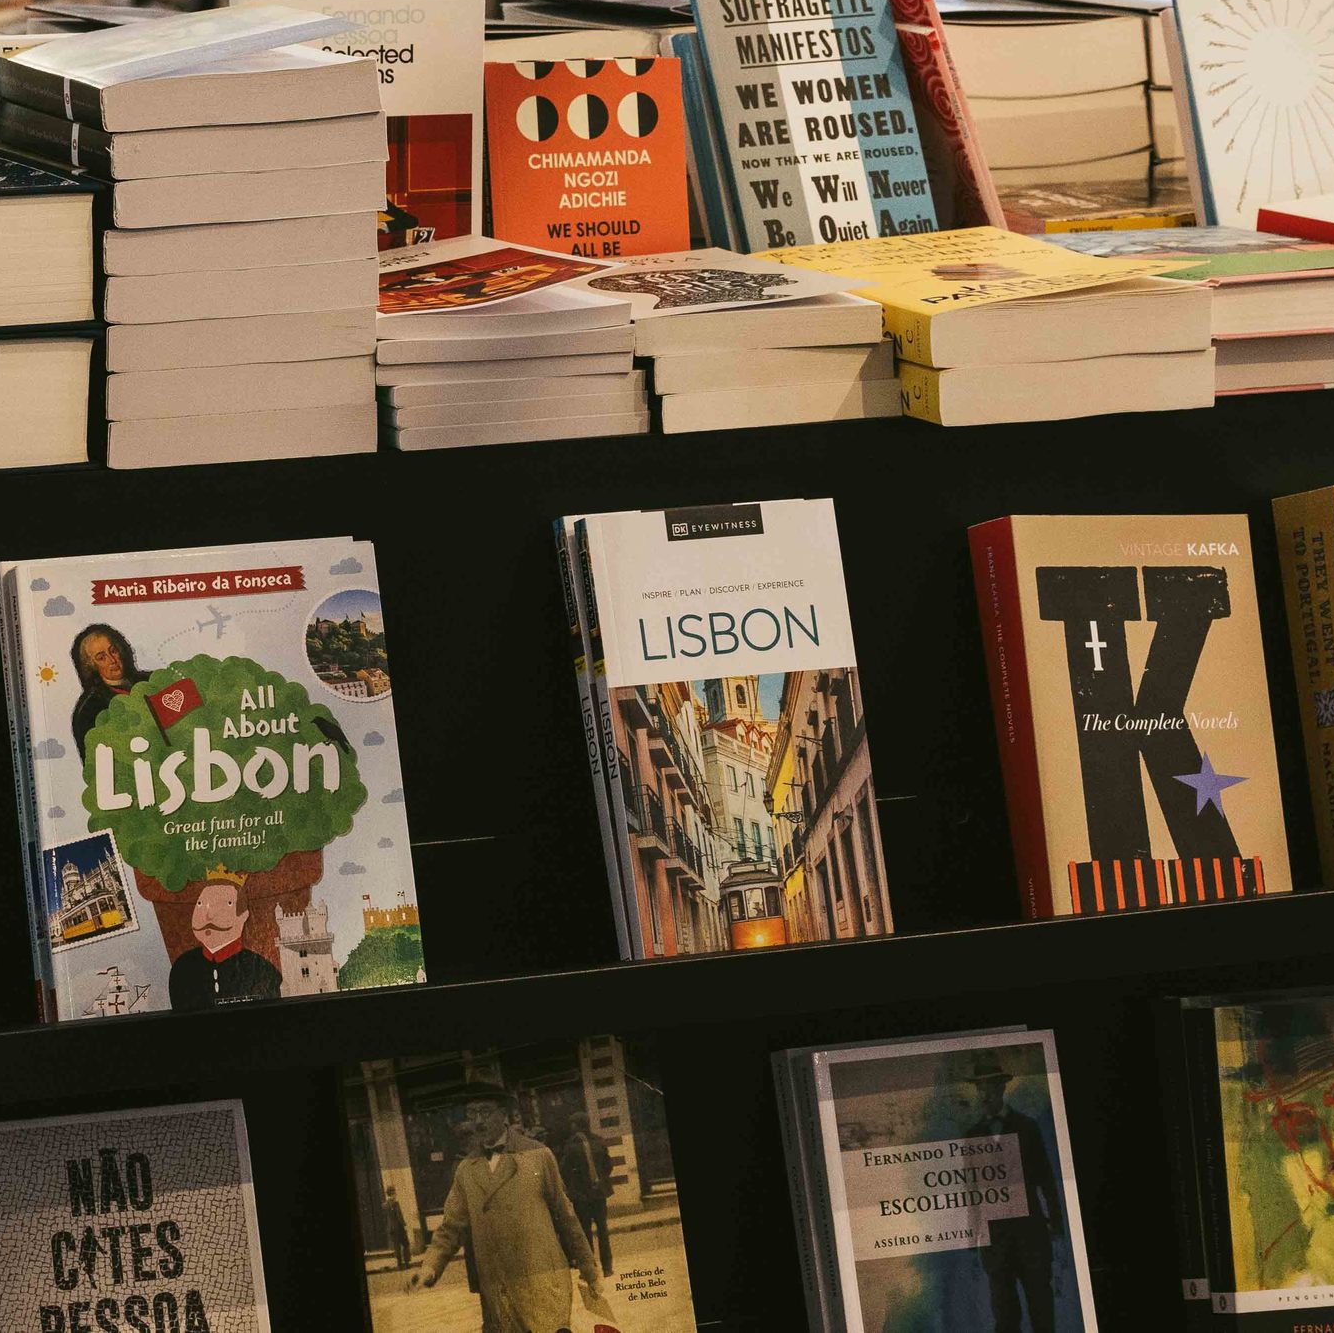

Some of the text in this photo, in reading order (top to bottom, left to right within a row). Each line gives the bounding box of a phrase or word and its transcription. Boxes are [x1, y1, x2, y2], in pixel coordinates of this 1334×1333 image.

[735, 27, 875, 67] MANIFESTOS
[736, 74, 891, 110] WE WOMEN
[739, 118, 791, 148] ARE
[806, 110, 914, 141] ROUSED.
[528, 150, 652, 169] CHIMAMANDA
[741, 157, 771, 169] NOW
[775, 154, 808, 166] THAT
[812, 152, 832, 163] WE
[835, 150, 860, 162] ARE
[564, 171, 619, 188] NGOZI
[751, 169, 929, 209] We Will Never
[559, 191, 627, 209] ADICHIE
[547, 219, 641, 239] WE SHOULD
[764, 210, 938, 248] Be Quiet Again.
[570, 241, 621, 258] ALL BE
[674, 519, 757, 535] DK EYEWITNESS
[1120, 543, 1240, 557] VINTAGE KAFKA
[1312, 531, 1327, 589] THEY
[104, 571, 292, 599] Maria Ribeiro da Fonseca
[642, 579, 804, 600] INSPIRE PLAN DISCOVER EXPERIENCE
[1291, 526, 1322, 684] TO PORTUGAL
[639, 605, 820, 661] LISBON
[986, 546, 1015, 744] FRANZ KAFKA THE COMPLETE NOVELS
[240, 685, 275, 710] All
[223, 713, 300, 739] About
[580, 695, 601, 776] LISBON
[1082, 712, 1240, 735] The Complete Novels
[599, 699, 619, 780] LISBON
[95, 728, 341, 816] Lisbon
[163, 810, 284, 836] Great fun for all
[185, 830, 267, 852] the family!
[67, 1146, 153, 1216] NÃO
[924, 1164, 1007, 1187] CONTOS
[879, 1187, 1010, 1216] ESCOLHIDOS
[874, 1229, 973, 1248] ASSÍRIO & ALVIM
[615, 1278, 666, 1292] Ricardo Belo
[620, 1267, 664, 1281] prefácio de
[628, 1290, 667, 1301] de Morais
[1278, 1293, 1334, 1302] PENGUIN
